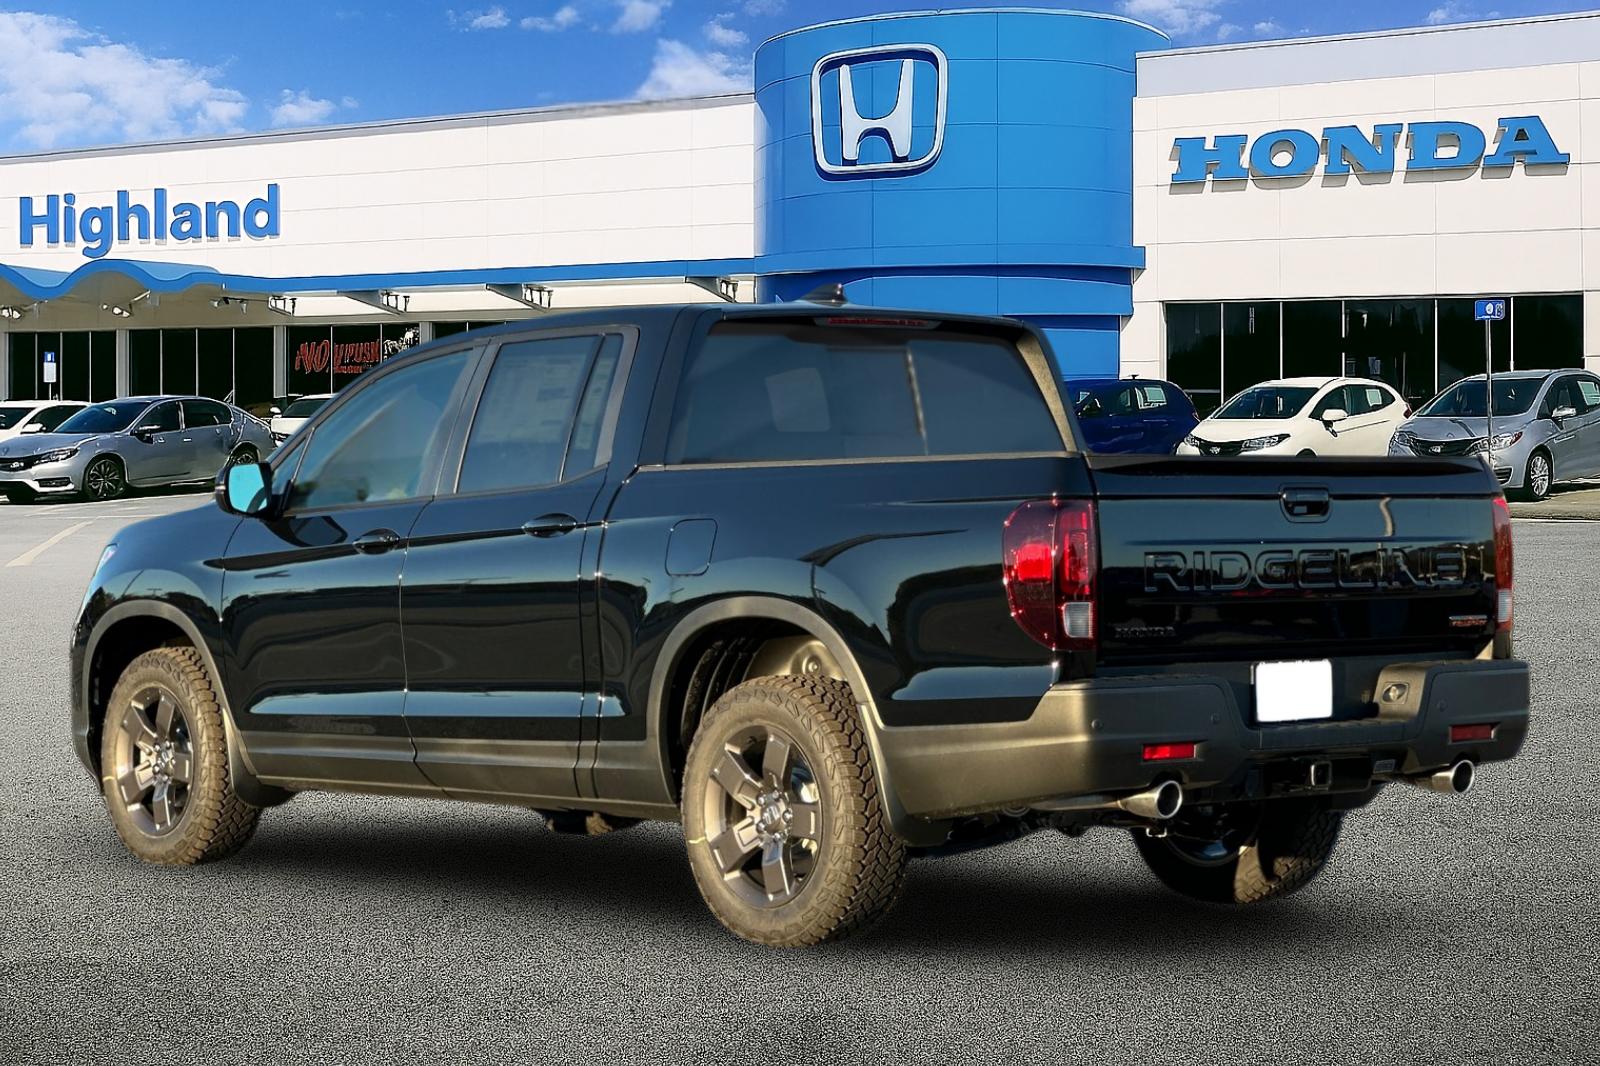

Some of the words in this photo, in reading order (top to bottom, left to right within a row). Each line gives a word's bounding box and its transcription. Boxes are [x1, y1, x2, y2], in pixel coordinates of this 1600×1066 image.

[1171, 115, 1570, 182] HONDA
[20, 183, 280, 258] Highland
[1143, 549, 1466, 592] RIDGELINE
